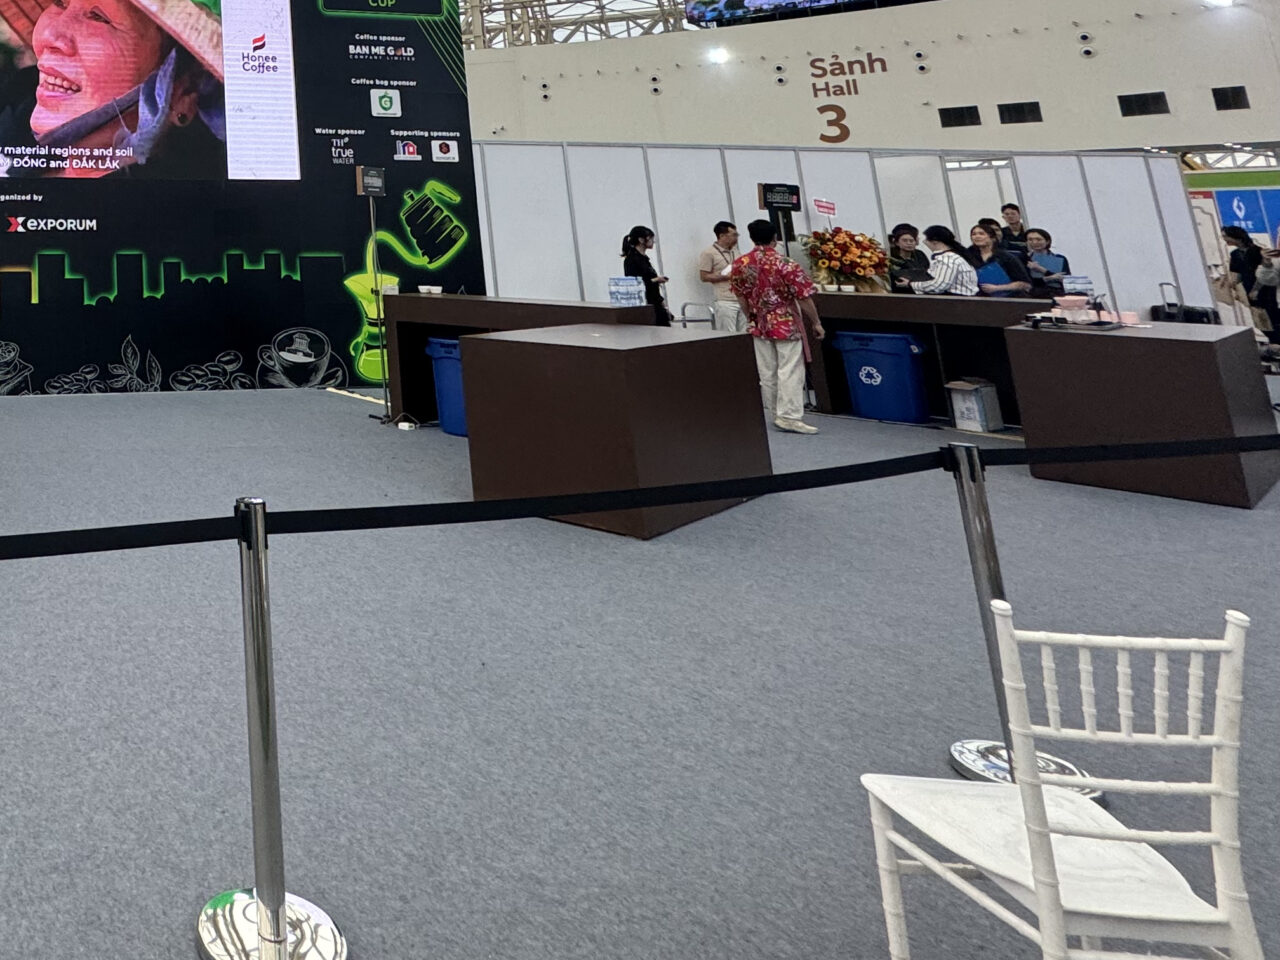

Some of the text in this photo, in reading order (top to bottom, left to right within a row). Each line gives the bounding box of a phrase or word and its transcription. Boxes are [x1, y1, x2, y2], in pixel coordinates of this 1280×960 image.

[379, 34, 406, 43] sponsor
[348, 45, 369, 54] BAN
[371, 46, 386, 55] ME
[242, 52, 277, 62] Honee
[242, 62, 278, 74] Coffee
[810, 52, 888, 78] Sảnh
[351, 78, 417, 88] Coffee bag sponsor
[812, 78, 859, 98] Hall
[816, 104, 851, 143] 3
[338, 128, 365, 136] sponsor
[390, 130, 460, 138] Supporting sponsors
[4, 145, 49, 155] material
[51, 146, 90, 157] regions
[93, 147, 113, 156] and
[116, 147, 133, 157] soil
[332, 146, 354, 158] true
[50, 159, 70, 168] and
[33, 194, 43, 202] by
